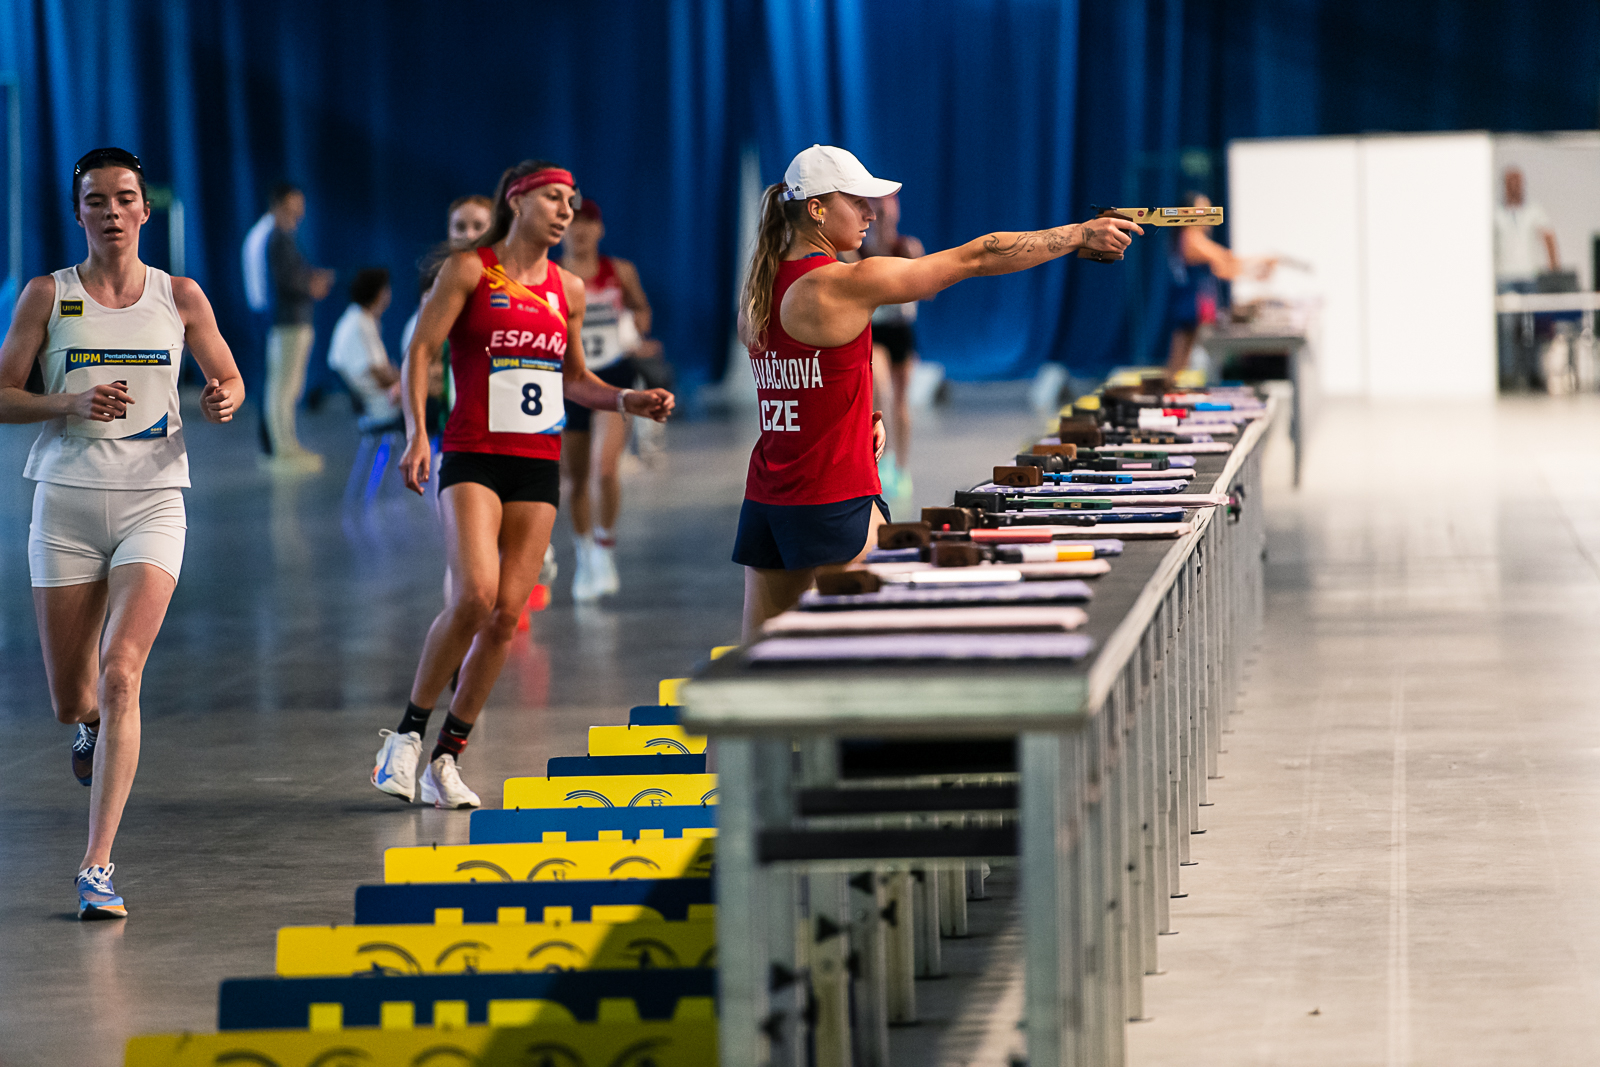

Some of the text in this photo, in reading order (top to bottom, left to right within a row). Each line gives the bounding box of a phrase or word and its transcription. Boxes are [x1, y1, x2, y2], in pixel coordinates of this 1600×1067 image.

[70, 353, 101, 363] UIPM
[521, 383, 543, 417] 8
[761, 400, 801, 432] CZE
